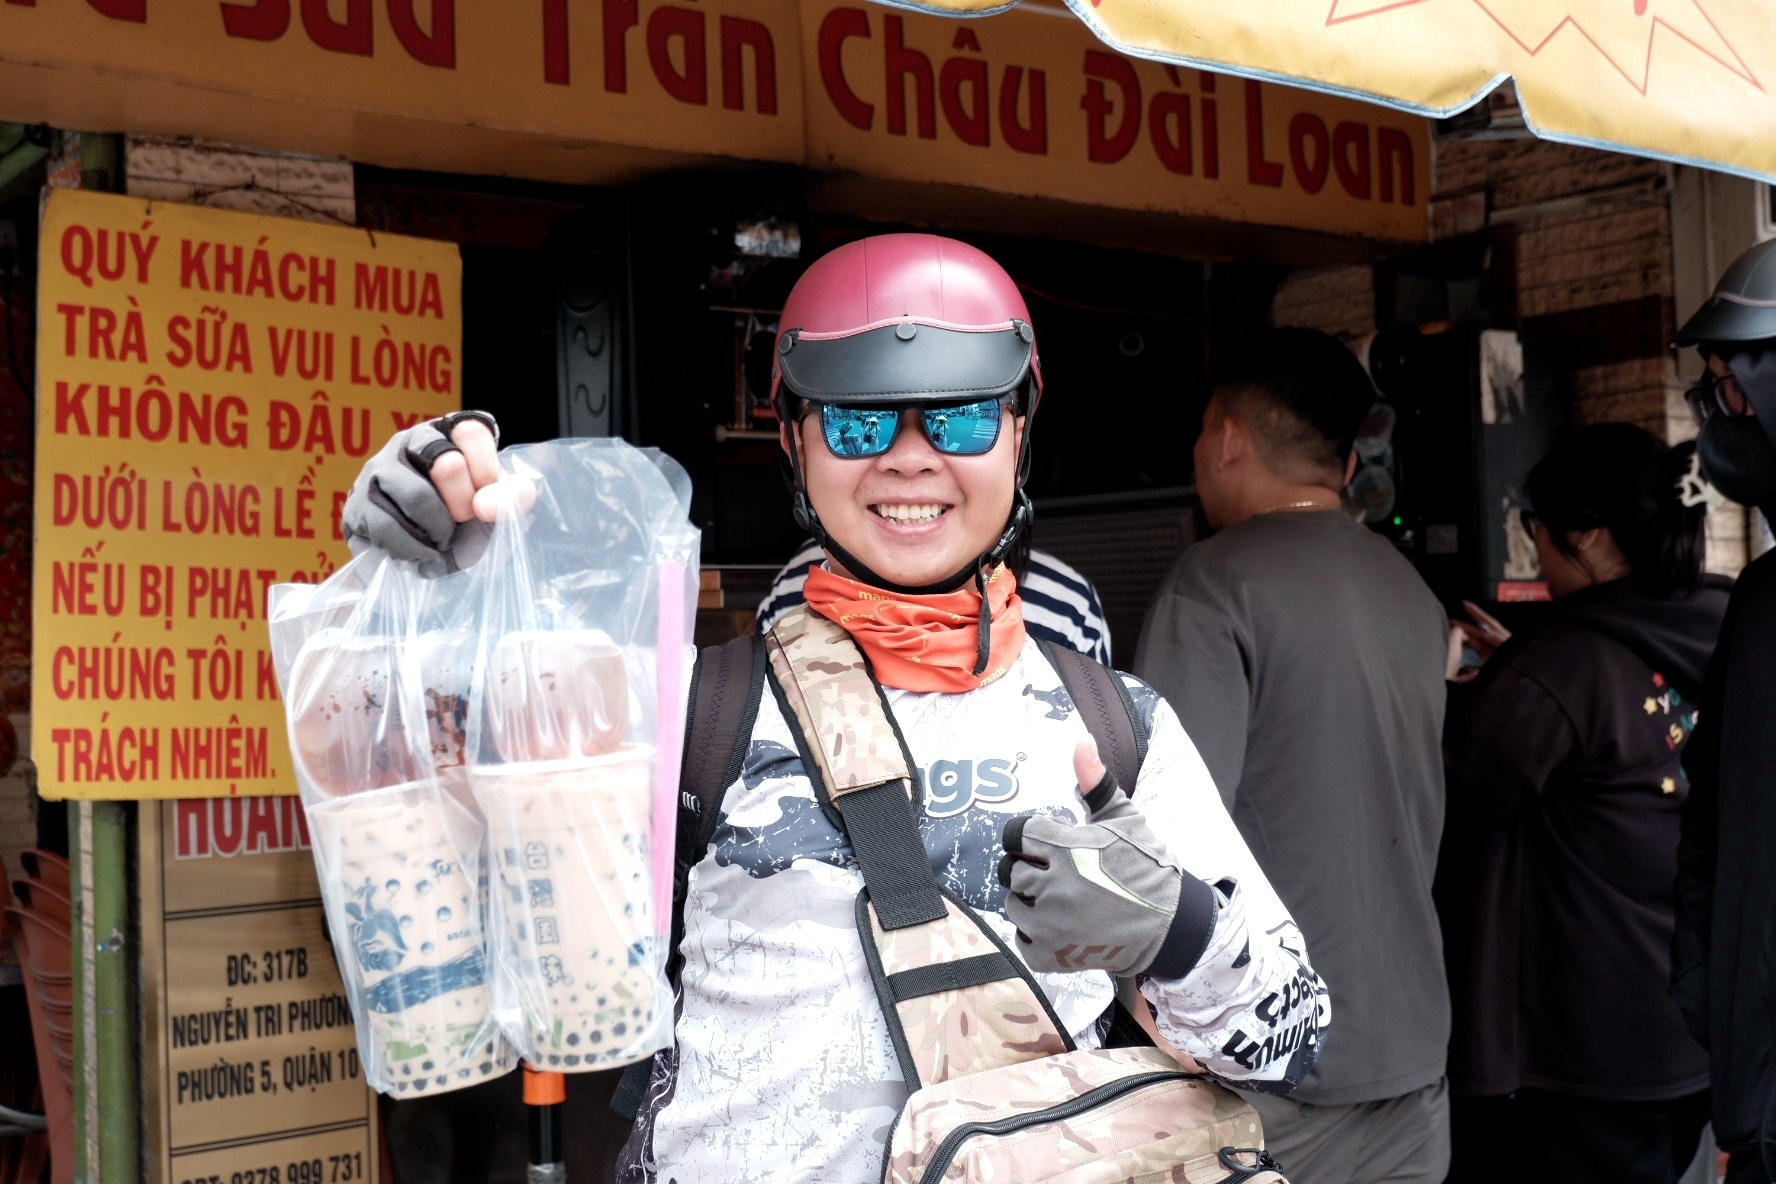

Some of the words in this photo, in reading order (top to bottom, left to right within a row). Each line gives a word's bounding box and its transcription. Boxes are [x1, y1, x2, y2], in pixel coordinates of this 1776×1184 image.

[818, 7, 1048, 156] Châu
[1081, 48, 1219, 180] Đài
[1245, 77, 1416, 206] Loan
[60, 220, 160, 287] QUÝ
[180, 236, 336, 306] KHÁCH
[354, 262, 444, 320] MUA
[57, 296, 148, 364] TRÀ
[166, 305, 253, 374] SỮA
[268, 326, 334, 381] VUI
[350, 325, 452, 394] LÒNG
[55, 374, 249, 449] KHÔNG
[267, 390, 371, 464] ĐẬU
[53, 462, 147, 530] DƯỚI
[162, 467, 260, 538] LÒNG
[274, 465, 317, 540] LỀ
[52, 541, 125, 616] NẾU
[139, 564, 173, 631] BỊ
[188, 566, 276, 631] PHẠT
[52, 632, 175, 701] CHÚNG
[187, 635, 243, 701] TÔI
[52, 712, 160, 783] TRÁCH
[171, 715, 275, 796] NHIỆM.
[917, 758, 1020, 818] gs
[227, 953, 257, 987] ĐC:
[263, 948, 308, 982] 317B
[172, 996, 249, 1049] NGUYỄN
[254, 1003, 283, 1037] TRI
[288, 993, 354, 1034] PHƯƠN
[177, 1057, 255, 1105] PHƯỜNG
[260, 1061, 278, 1096] 5,
[283, 1046, 332, 1093] QUẬN
[338, 1048, 359, 1080] 10
[287, 1159, 323, 1184] 999
[329, 1152, 362, 1182] 731
